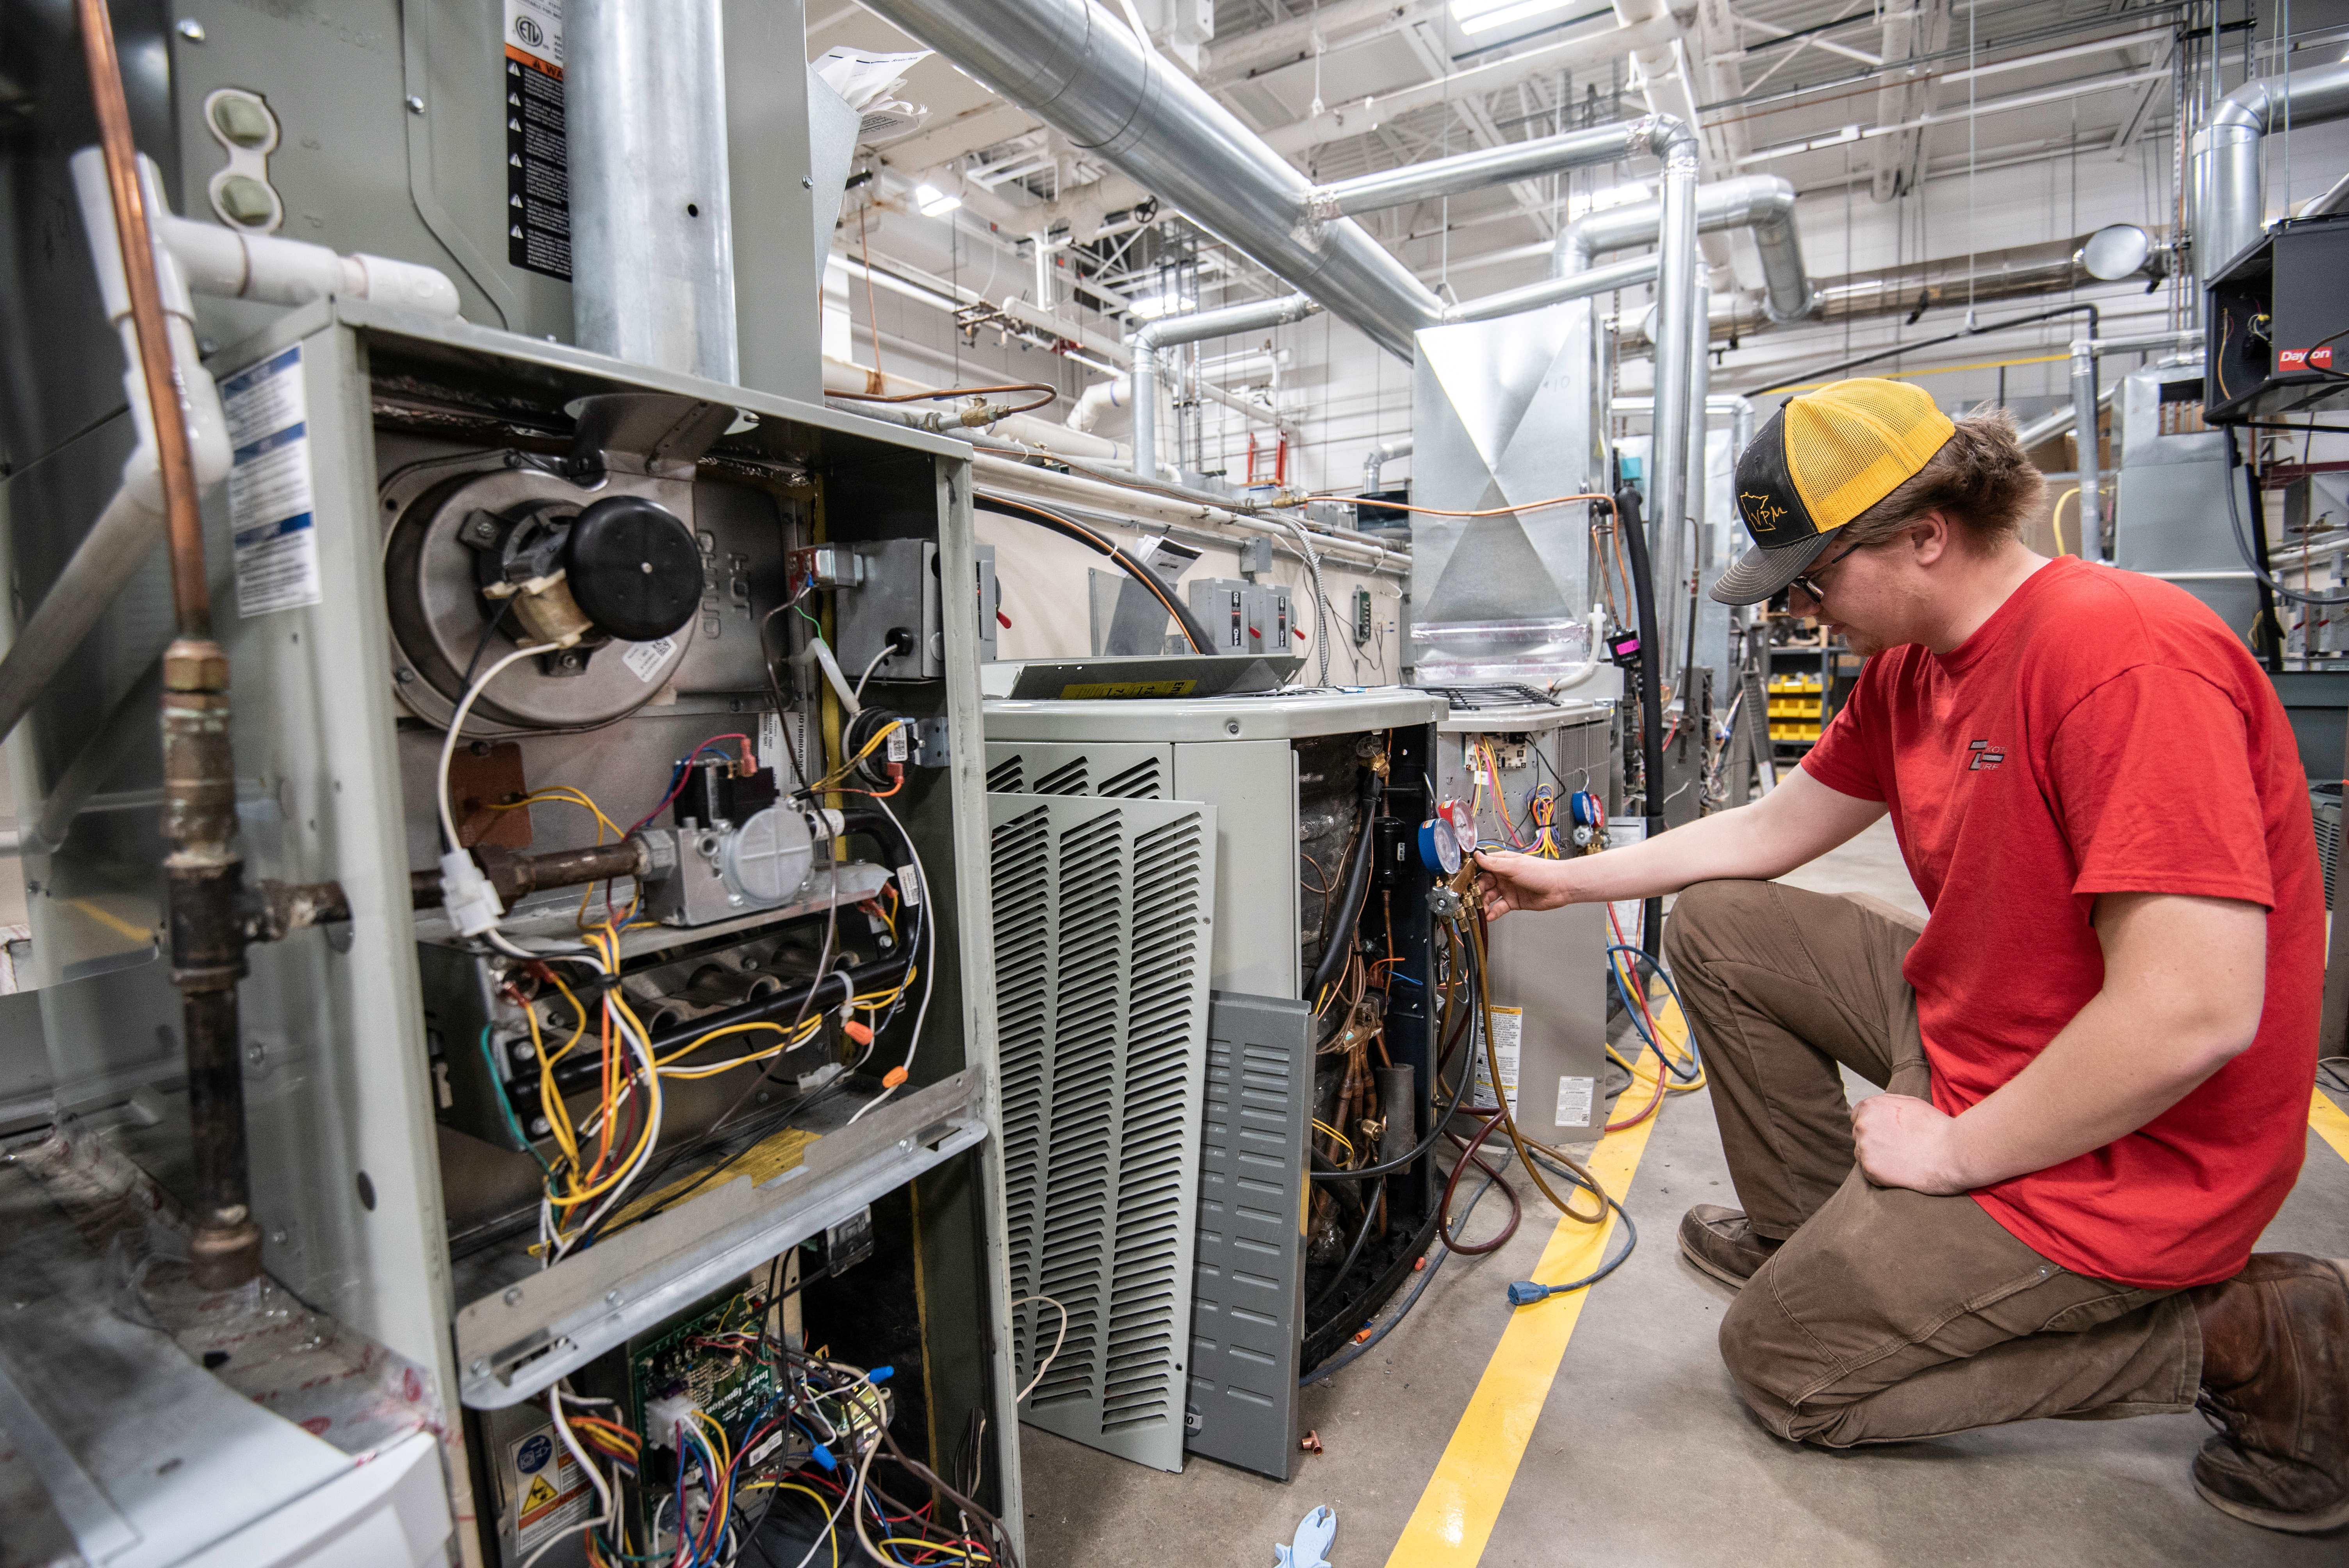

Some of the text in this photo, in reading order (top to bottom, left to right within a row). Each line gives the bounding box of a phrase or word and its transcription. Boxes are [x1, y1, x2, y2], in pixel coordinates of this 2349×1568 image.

[2279, 350, 2330, 363] Dayon
[1751, 506, 1788, 526] VPM
[1233, 592, 1239, 603] ON
[1280, 597, 1284, 608] ON
